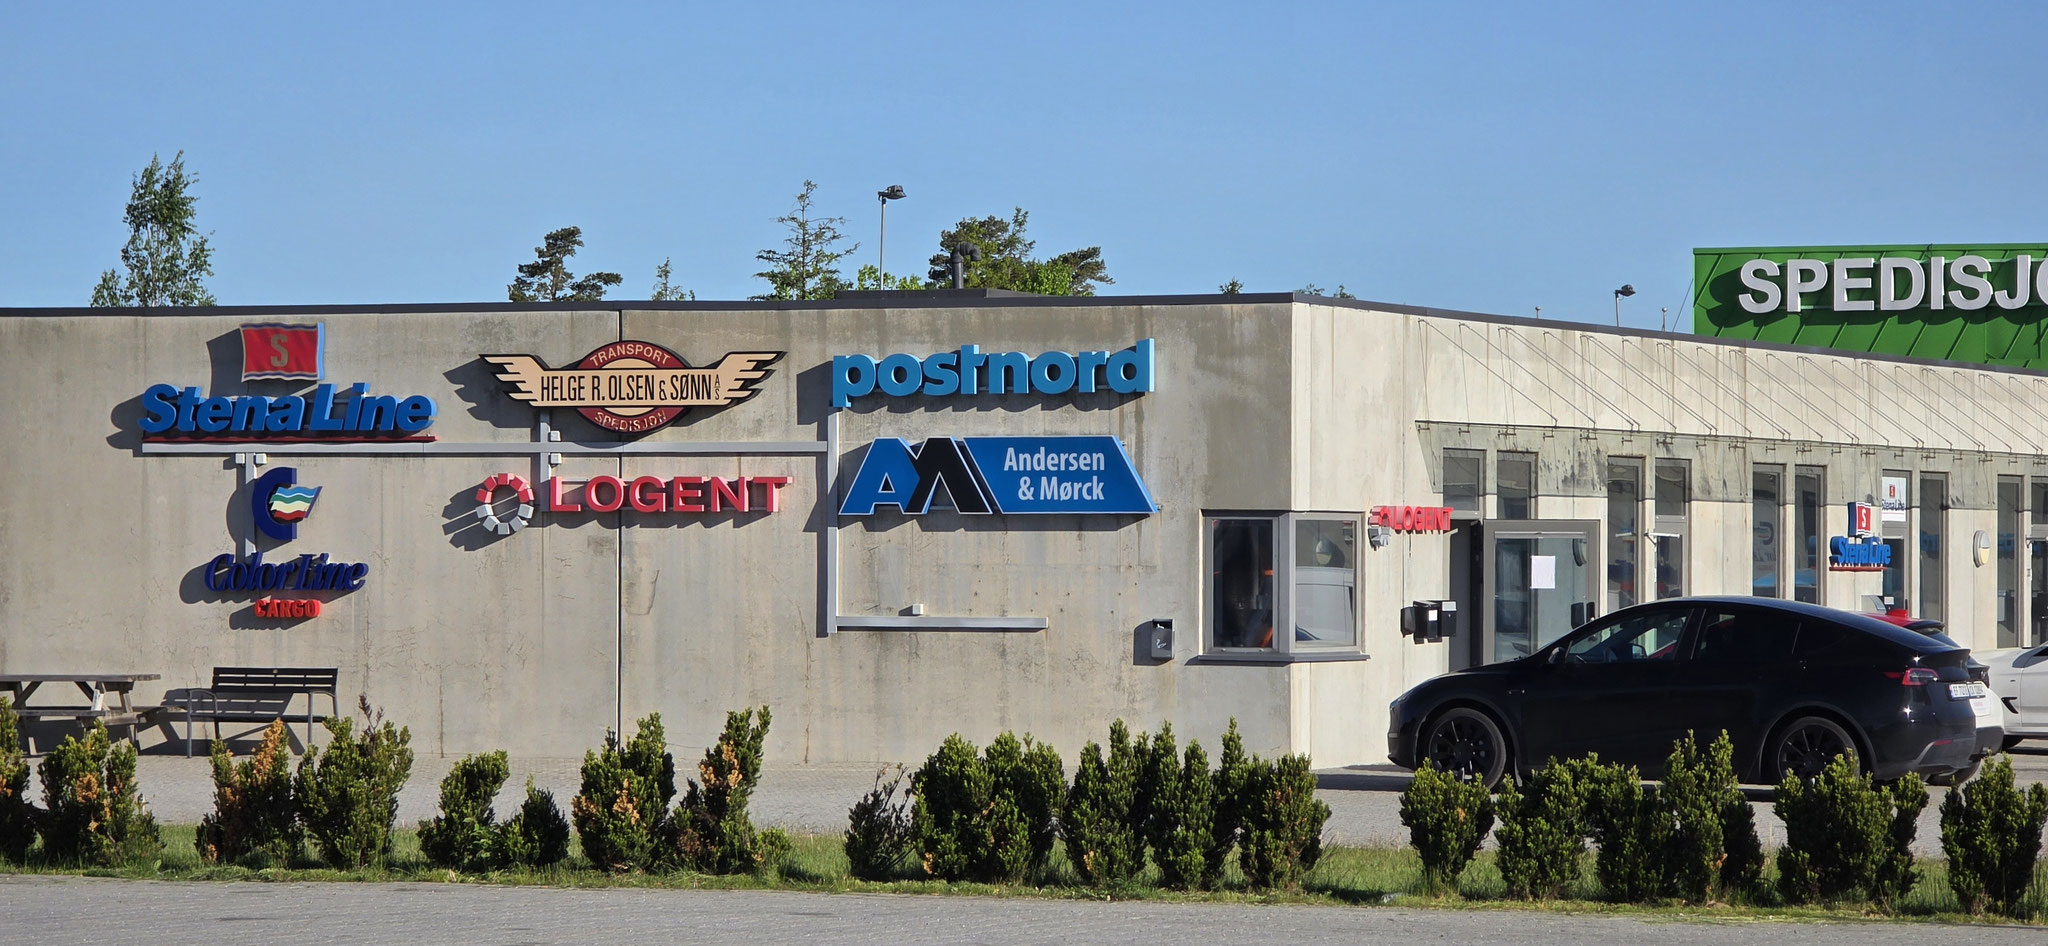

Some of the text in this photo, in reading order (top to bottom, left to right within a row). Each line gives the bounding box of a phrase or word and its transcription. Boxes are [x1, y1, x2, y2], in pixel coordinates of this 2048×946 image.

[1738, 254, 2048, 314] SPEDISJ
[270, 333, 289, 368] S
[589, 343, 672, 367] TRANSPORT
[832, 338, 1155, 407] postnord
[540, 375, 586, 402] HELGE
[591, 375, 606, 401] R.
[608, 375, 655, 401] OLSEN
[659, 380, 668, 401] &
[670, 373, 712, 402] SØNN
[138, 382, 438, 432] Stena Line
[594, 409, 668, 433] SPEDISJON
[1003, 447, 1105, 472] Andersen
[549, 475, 793, 513] LOGENT
[1017, 475, 1105, 501] & Mørck
[1393, 506, 1454, 531] LOGENT
[1836, 537, 1870, 565] Stena
[1869, 537, 1892, 565] Line
[205, 551, 369, 592] Color Line
[254, 599, 321, 618] CARGO
